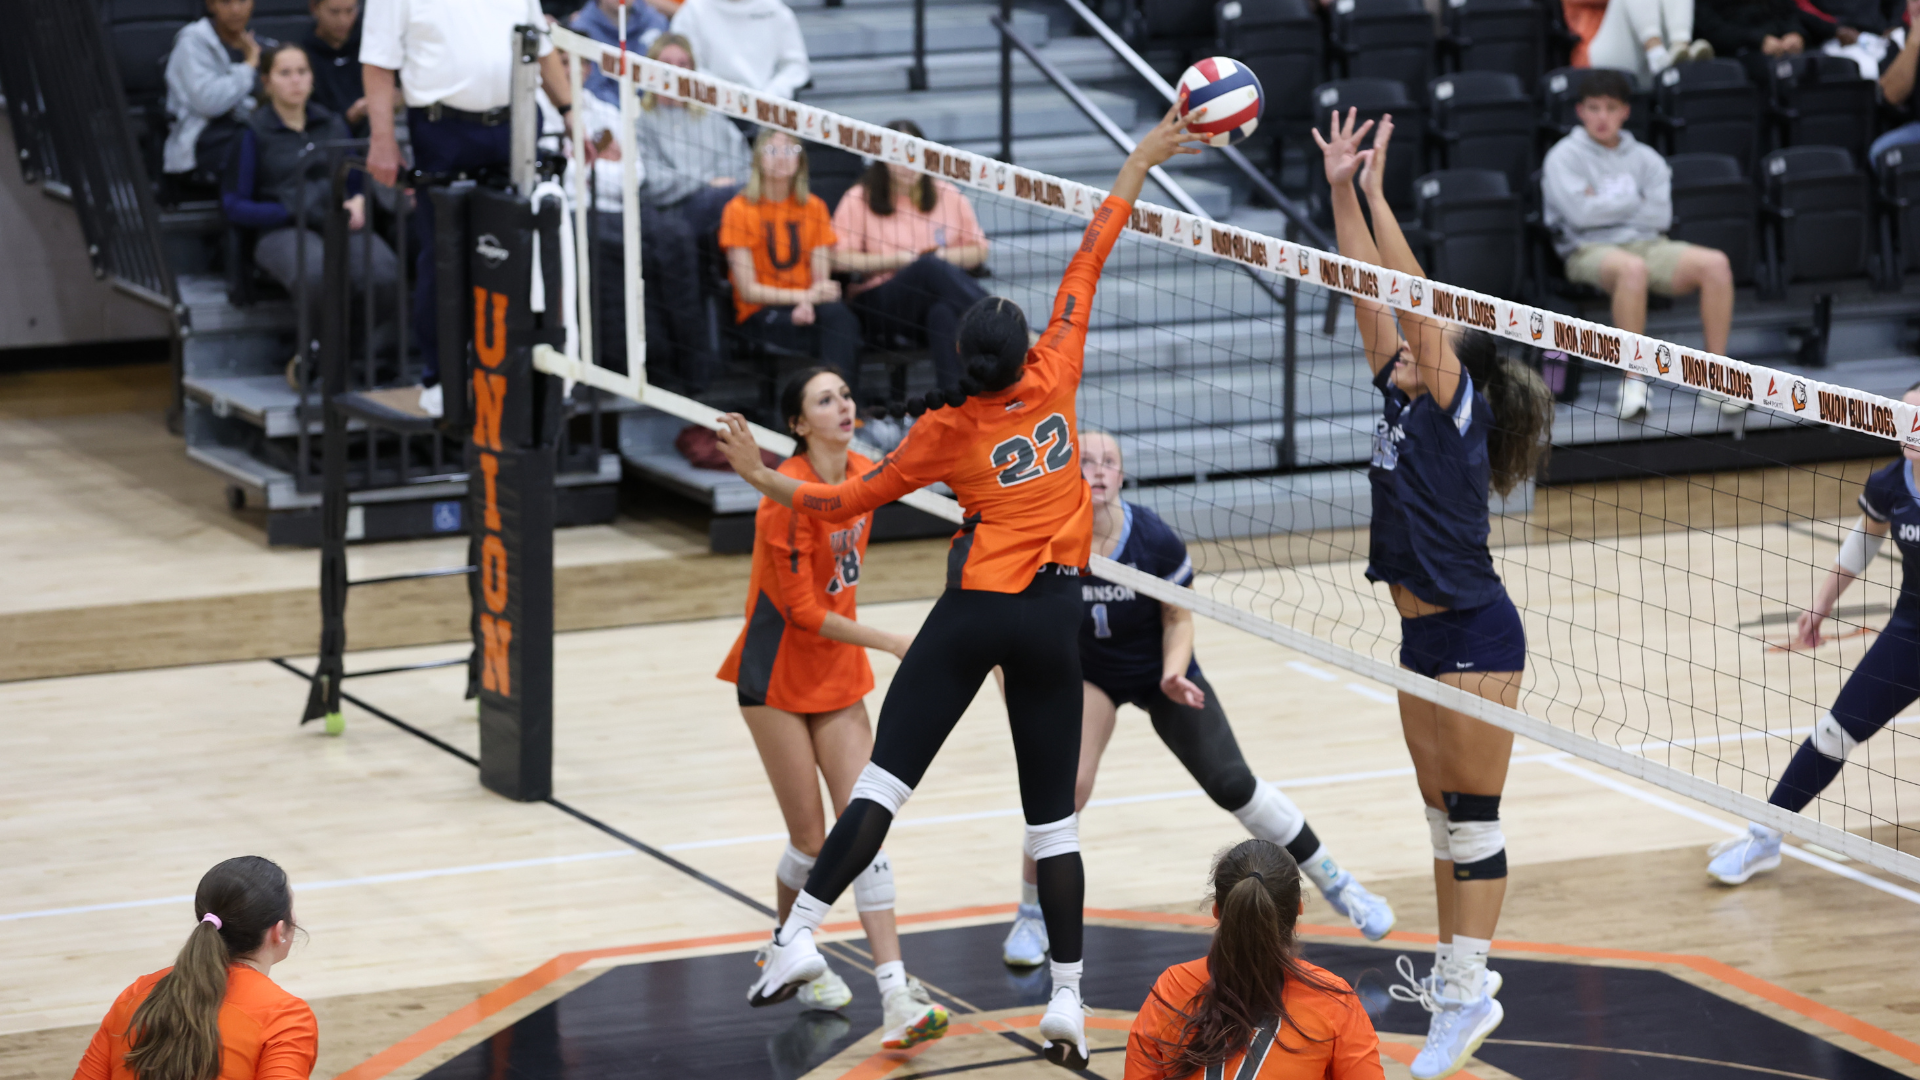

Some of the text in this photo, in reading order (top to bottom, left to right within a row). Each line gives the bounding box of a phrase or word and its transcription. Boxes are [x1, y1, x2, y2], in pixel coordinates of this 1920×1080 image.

[761, 220, 801, 270] U
[1081, 206, 1113, 253] BULLDOGS
[1432, 288, 1497, 331] UNION BULLDOGS
[1554, 320, 1621, 365] UNION BULLDOGS
[1681, 354, 1754, 401] UNION BULLDOGS
[1818, 390, 1897, 438] UNION BULLDOGS
[990, 412, 1074, 488] 22
[473, 285, 512, 697] UNION
[1091, 603, 1112, 639] 1
